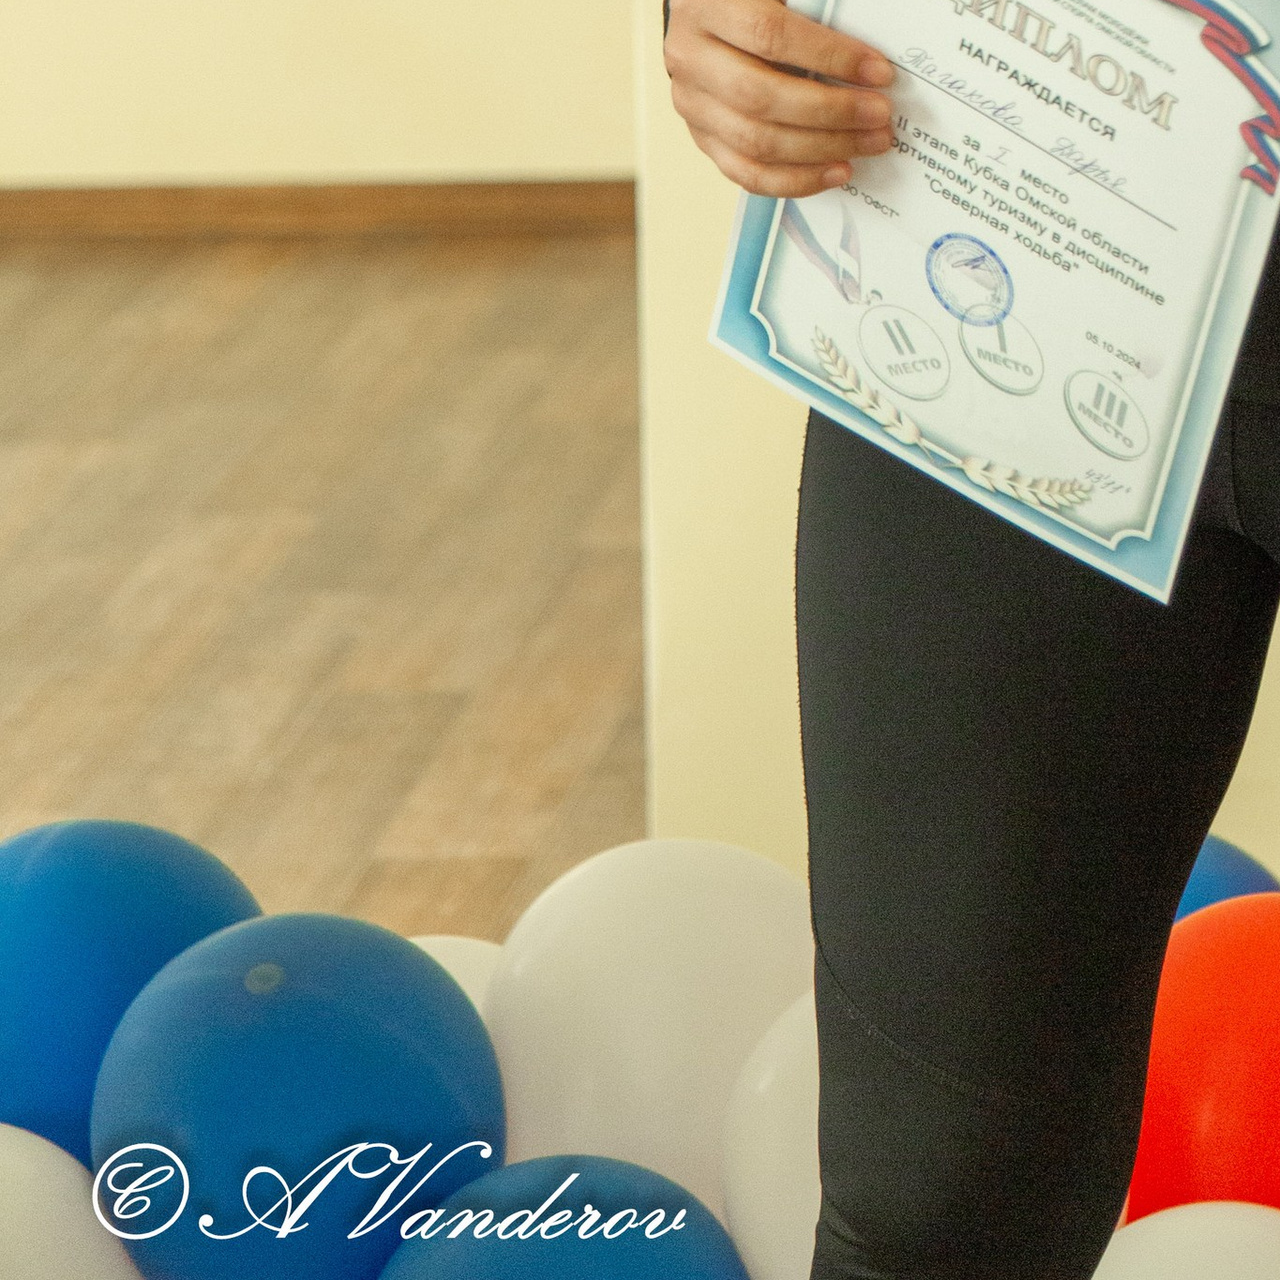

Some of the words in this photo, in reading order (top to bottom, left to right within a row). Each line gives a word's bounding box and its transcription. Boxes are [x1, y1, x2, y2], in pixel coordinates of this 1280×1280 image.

[959, 38, 1116, 142] НАГРАЖДАЕТСЯ
[962, 134, 981, 152] за
[1020, 168, 1070, 205] место
[891, 135, 976, 193] ортивному
[982, 189, 1048, 237] туризму
[1051, 231, 1062, 244] в
[1064, 241, 1166, 306] дисциплине
[910, 126, 959, 160] этапе
[963, 153, 1010, 192] Кубка
[1014, 185, 1078, 231] Омской
[1080, 228, 1150, 275] области
[924, 173, 1010, 235] "Северная
[1013, 230, 1080, 273] ходьба"
[887, 358, 942, 377] МЕСТО
[976, 347, 1034, 377] МЕСТО
[1085, 330, 1142, 372] 05.10.2024
[1077, 402, 1134, 449] МЕСТО
[1093, 383, 1129, 429] III
